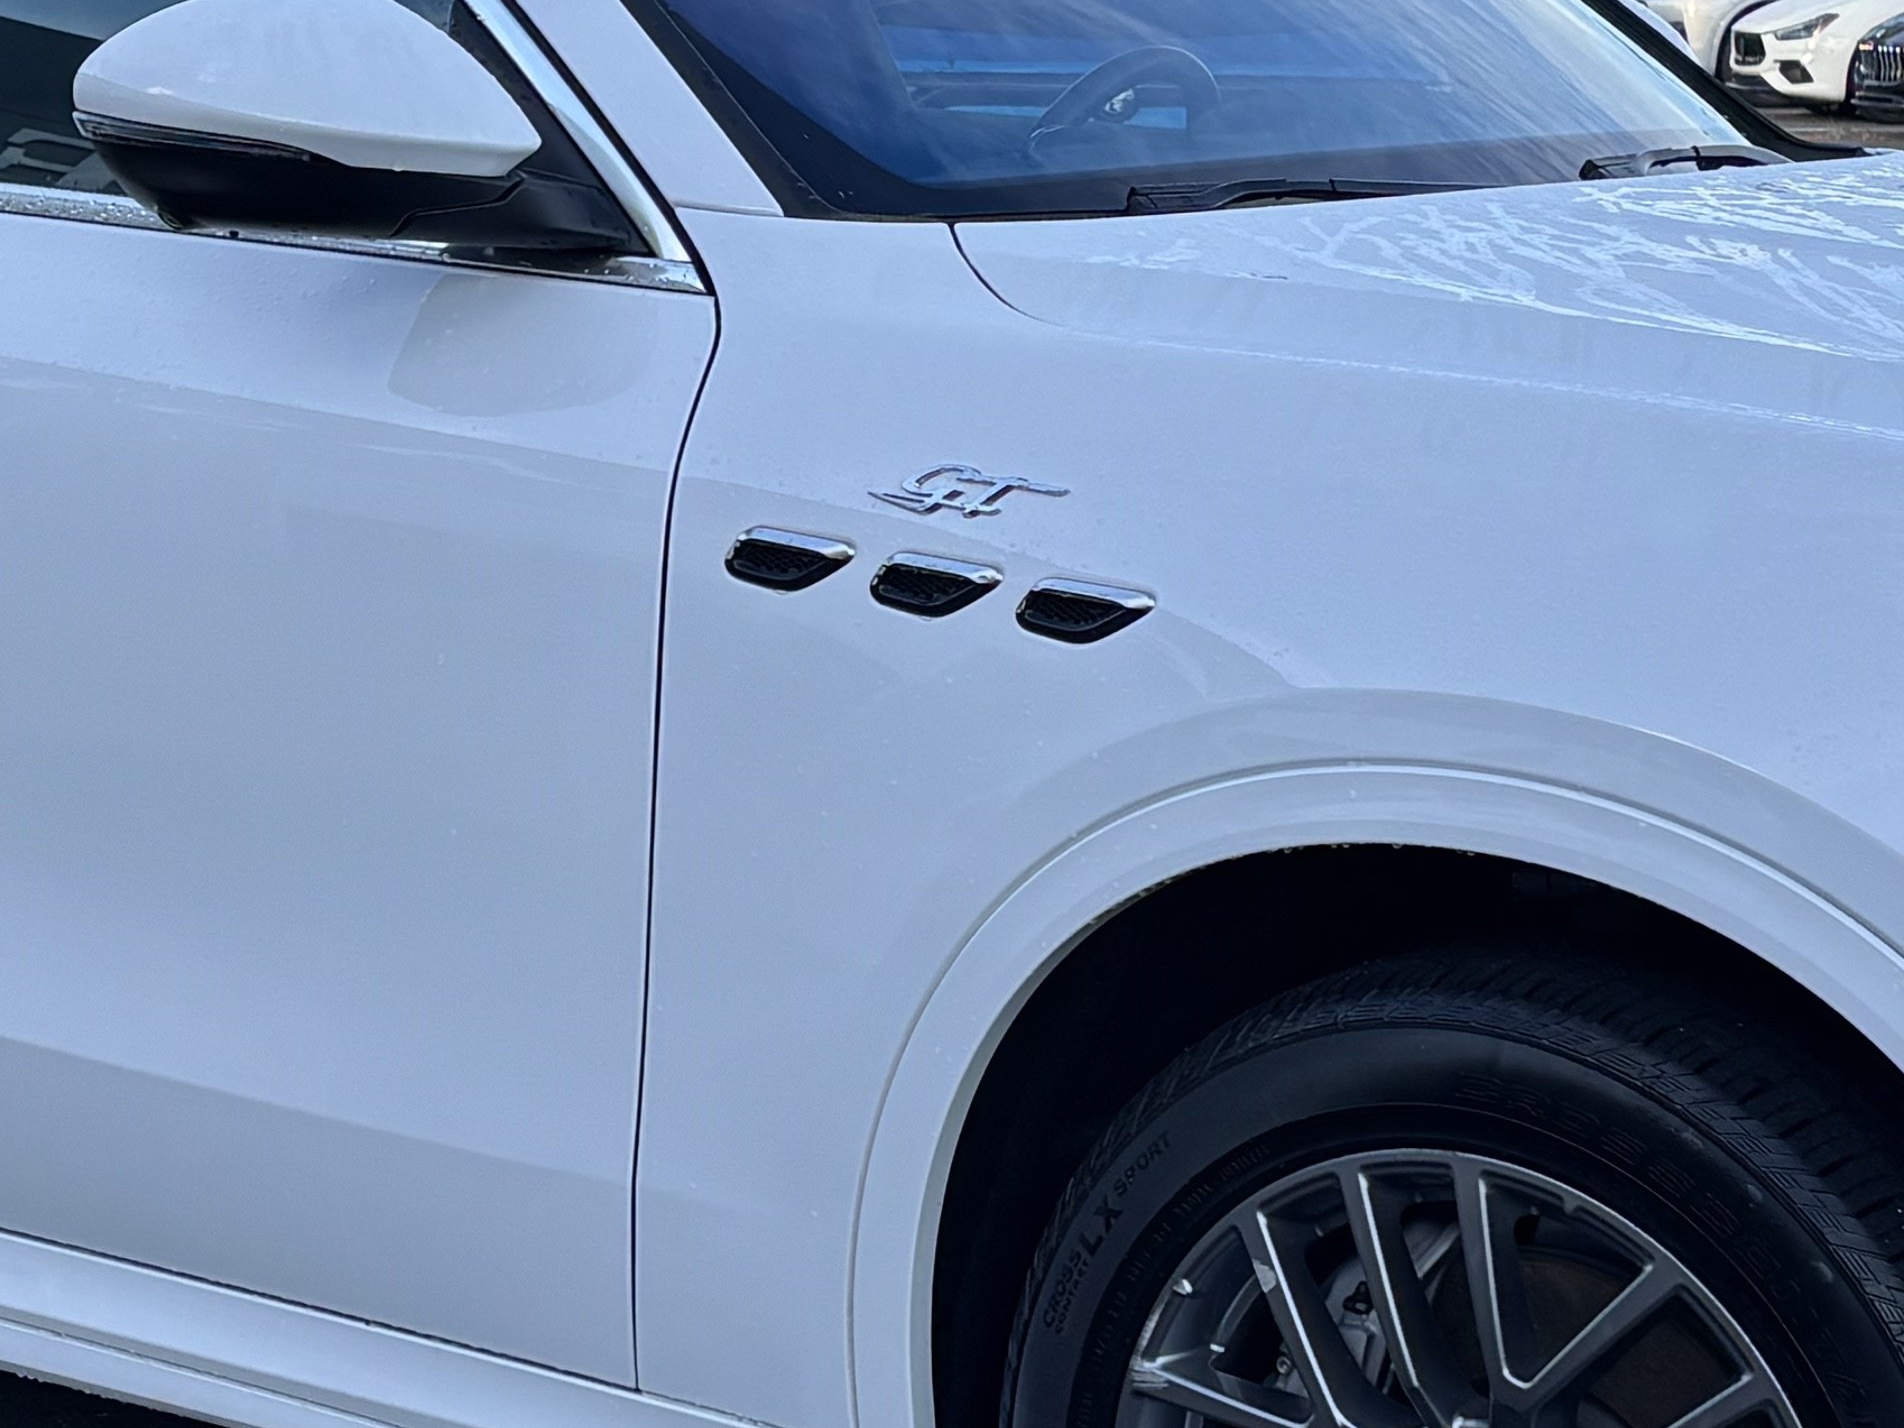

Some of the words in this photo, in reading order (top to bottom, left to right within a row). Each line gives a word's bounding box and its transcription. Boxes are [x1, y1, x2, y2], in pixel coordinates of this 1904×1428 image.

[867, 463, 1072, 519] GT
[1042, 1248, 1082, 1330] CROSS
[1112, 1131, 1172, 1197] SPORT
